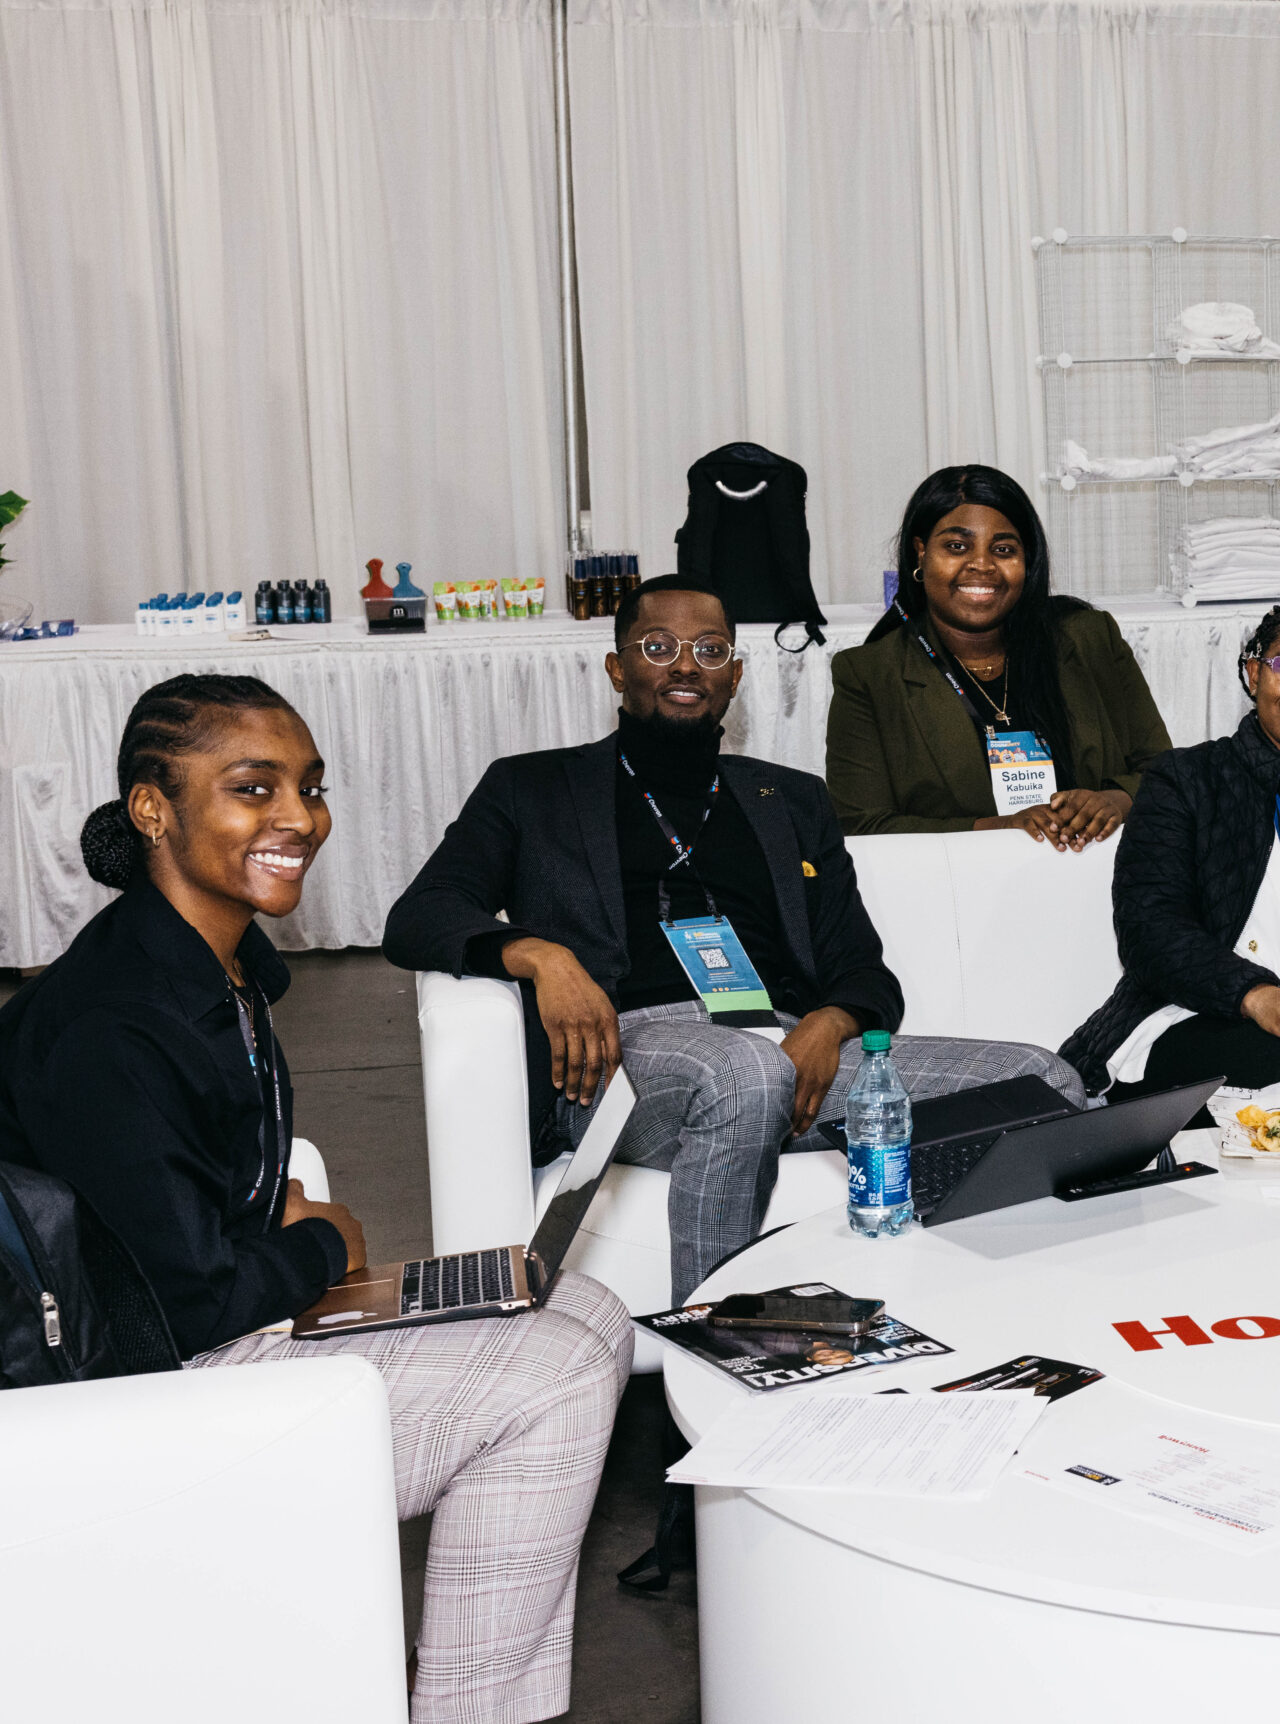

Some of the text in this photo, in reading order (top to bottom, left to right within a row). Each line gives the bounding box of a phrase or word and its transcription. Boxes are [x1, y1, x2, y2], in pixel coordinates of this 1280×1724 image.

[945, 672, 960, 690] Chevron
[1001, 770, 1046, 782] Sabine
[1006, 783, 1043, 792] Kabuika
[648, 799, 663, 818] Chevron
[668, 851, 689, 870] Chevron
[732, 1364, 764, 1374] TOP
